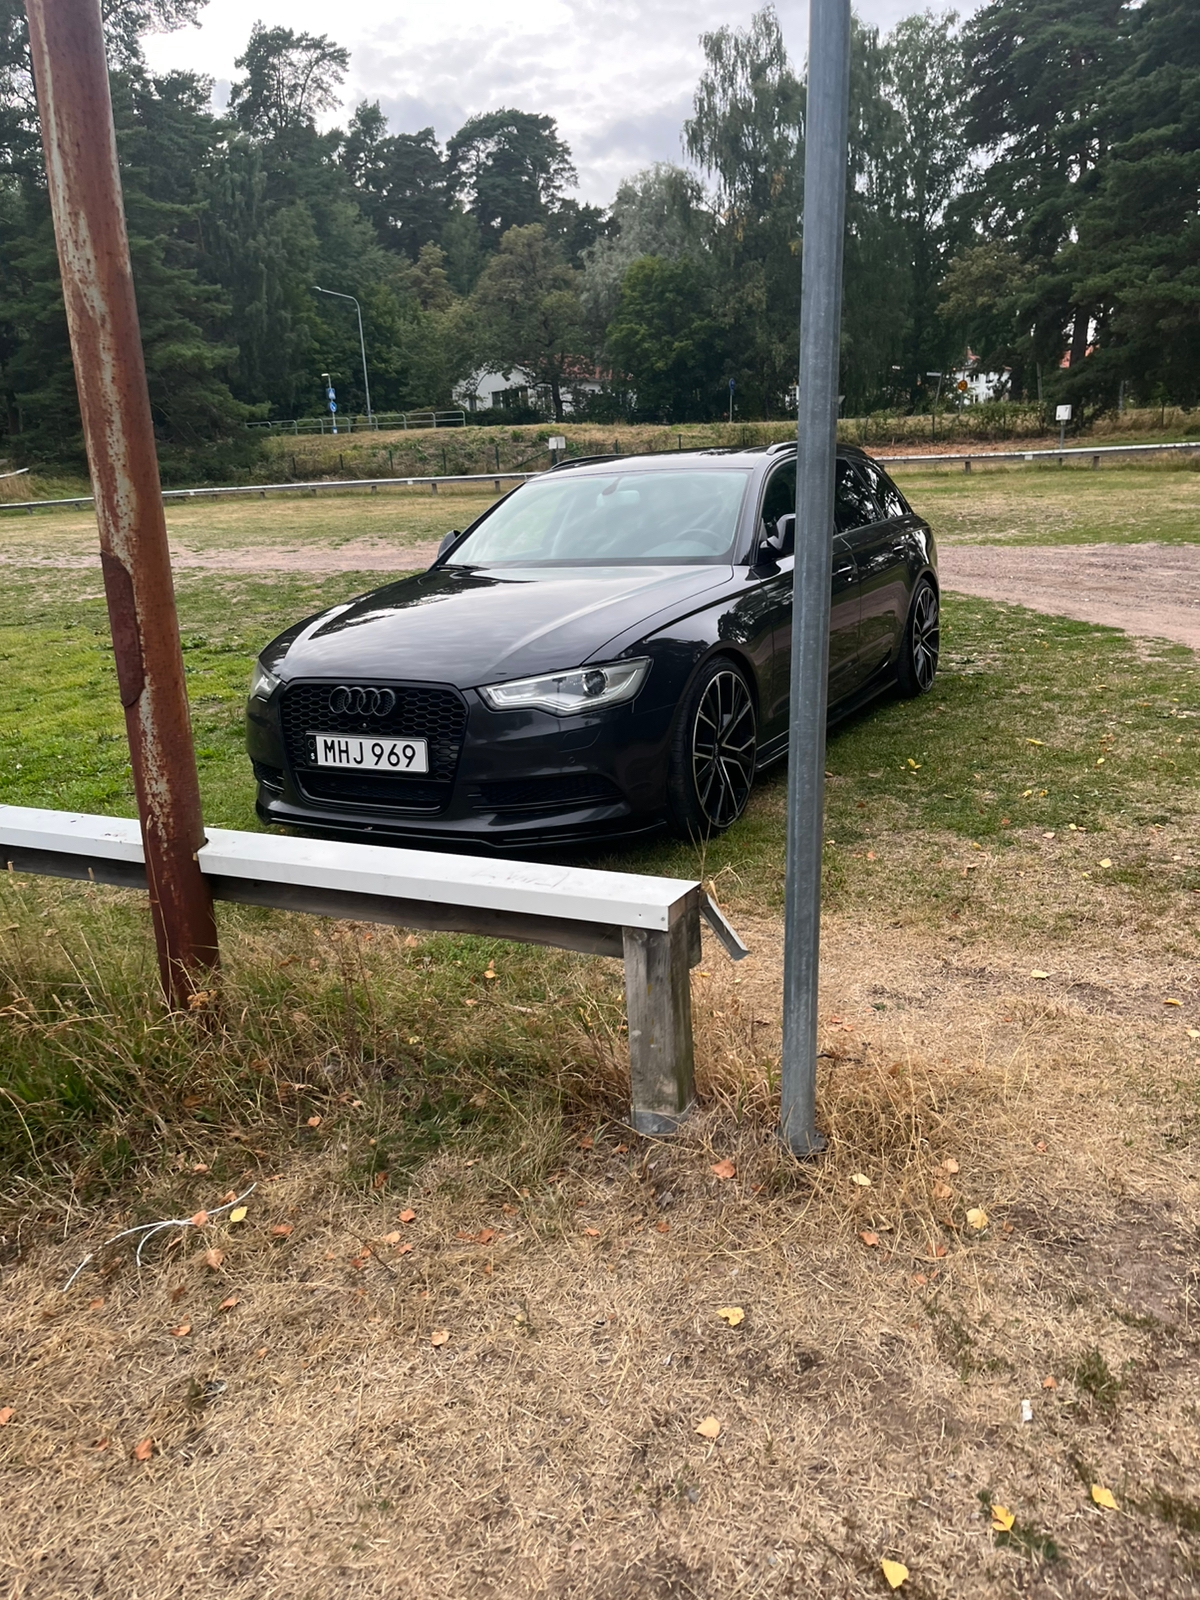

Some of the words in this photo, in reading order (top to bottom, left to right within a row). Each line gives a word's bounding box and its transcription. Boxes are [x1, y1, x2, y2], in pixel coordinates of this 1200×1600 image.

[310, 752, 316, 760] S
[323, 739, 363, 764] MHJ
[371, 742, 416, 768] 969
